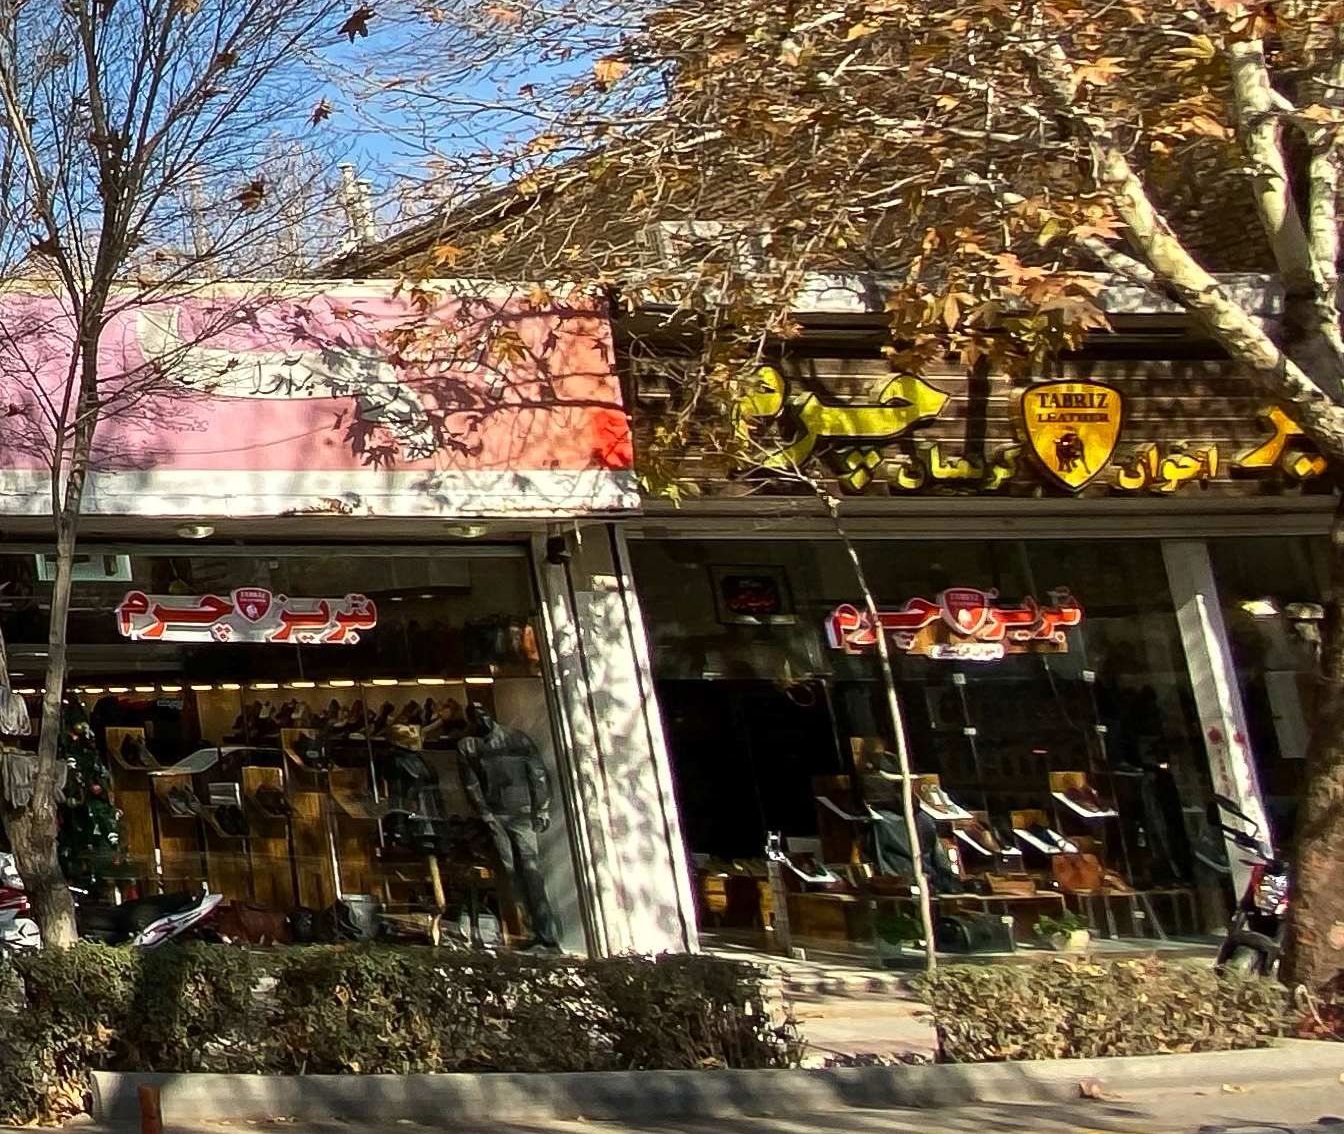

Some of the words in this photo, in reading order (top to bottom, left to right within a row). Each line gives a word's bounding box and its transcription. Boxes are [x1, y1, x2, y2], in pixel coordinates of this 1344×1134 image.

[1038, 392, 1109, 409] TABRIZ
[117, 590, 236, 643] چرم
[265, 593, 378, 644] تبریز
